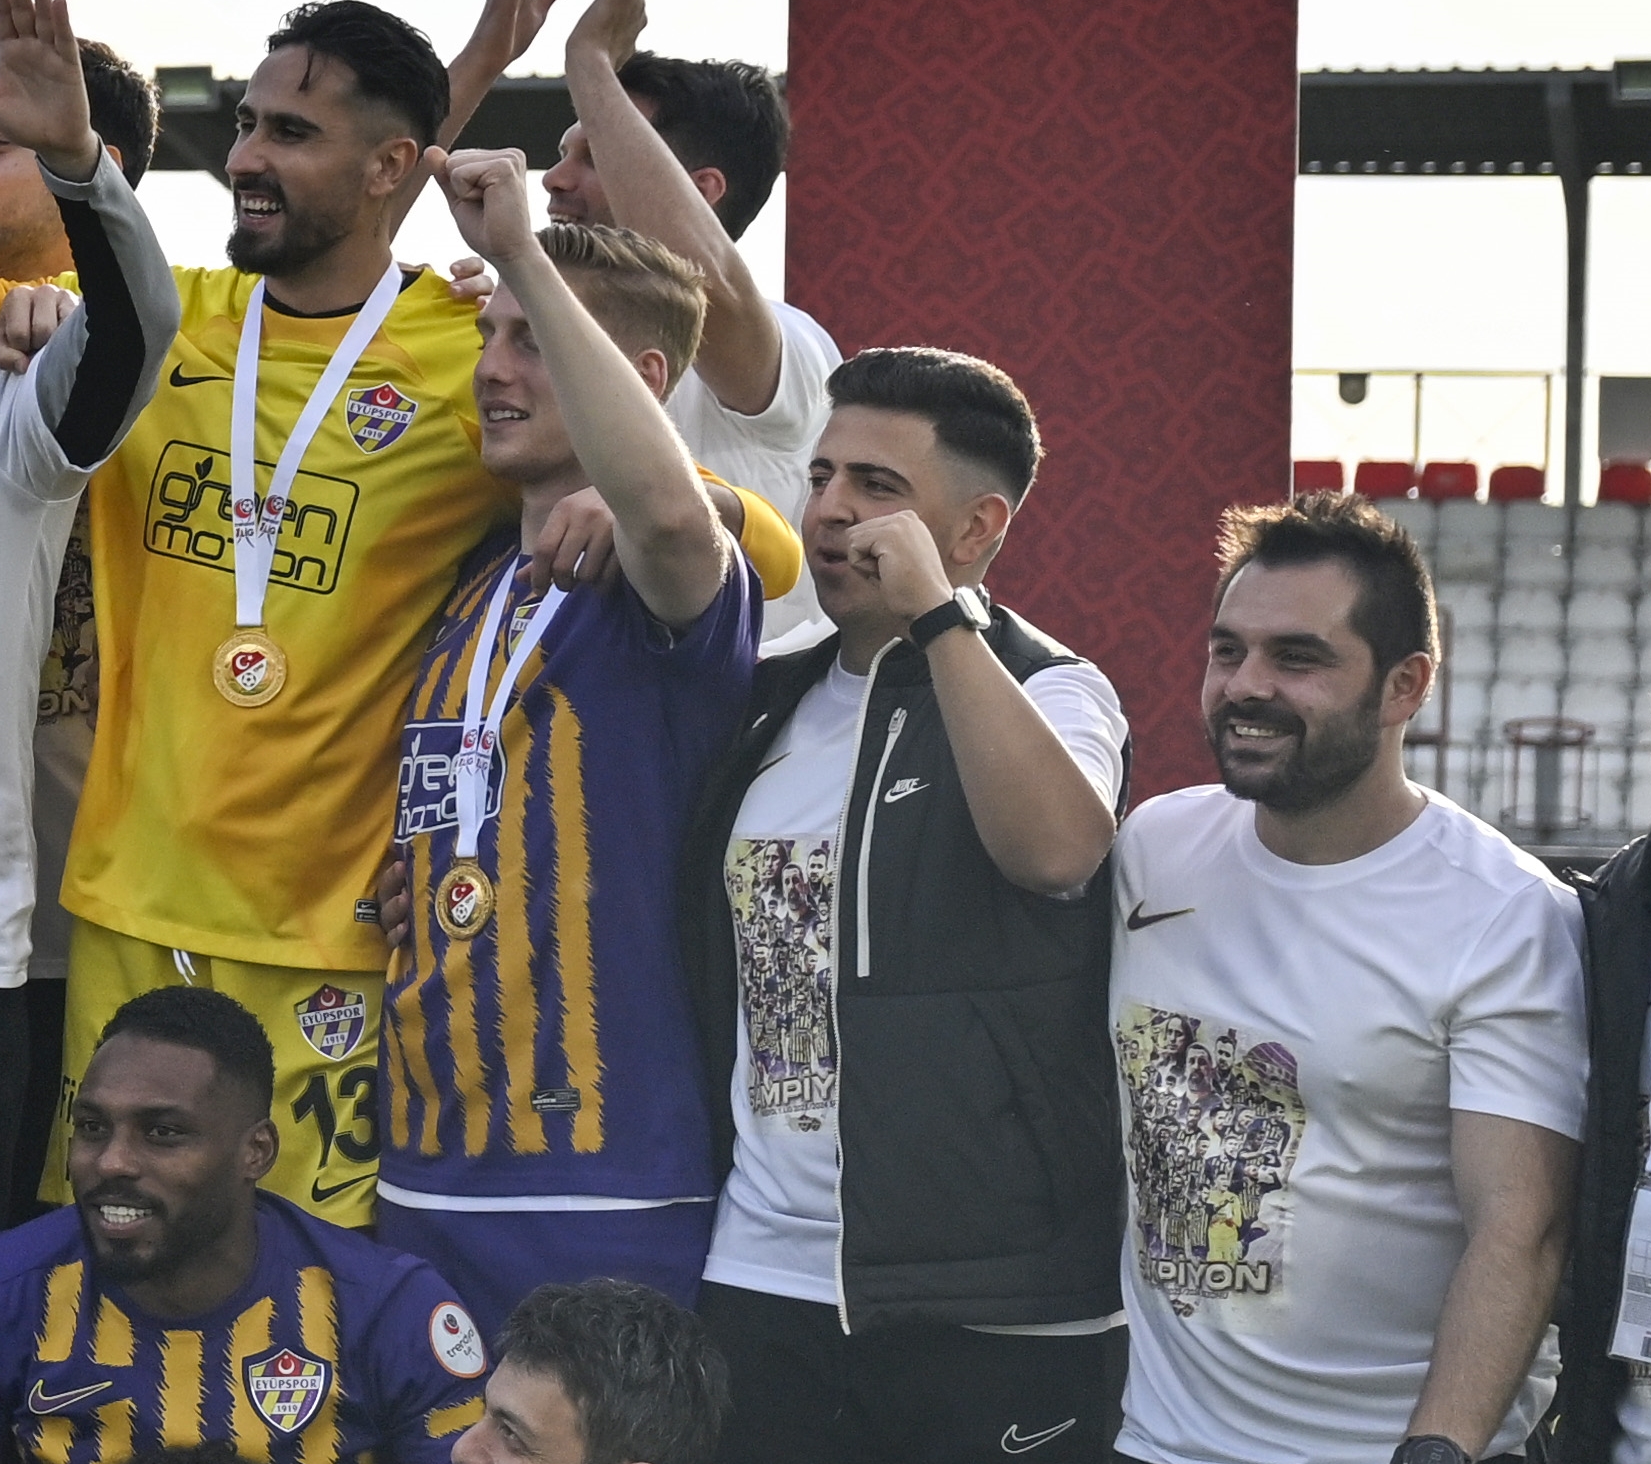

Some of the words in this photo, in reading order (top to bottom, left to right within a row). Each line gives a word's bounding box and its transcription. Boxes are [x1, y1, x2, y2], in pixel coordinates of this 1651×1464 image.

[350, 401, 407, 423] EYÜPSPOR
[361, 429, 383, 440] 1919
[893, 777, 921, 793] NIKE
[301, 1006, 363, 1026] EYÜPSPOR
[292, 1066, 382, 1171] 13
[255, 1378, 318, 1390] EYÜPSPOR
[277, 1404, 298, 1414] 1919
